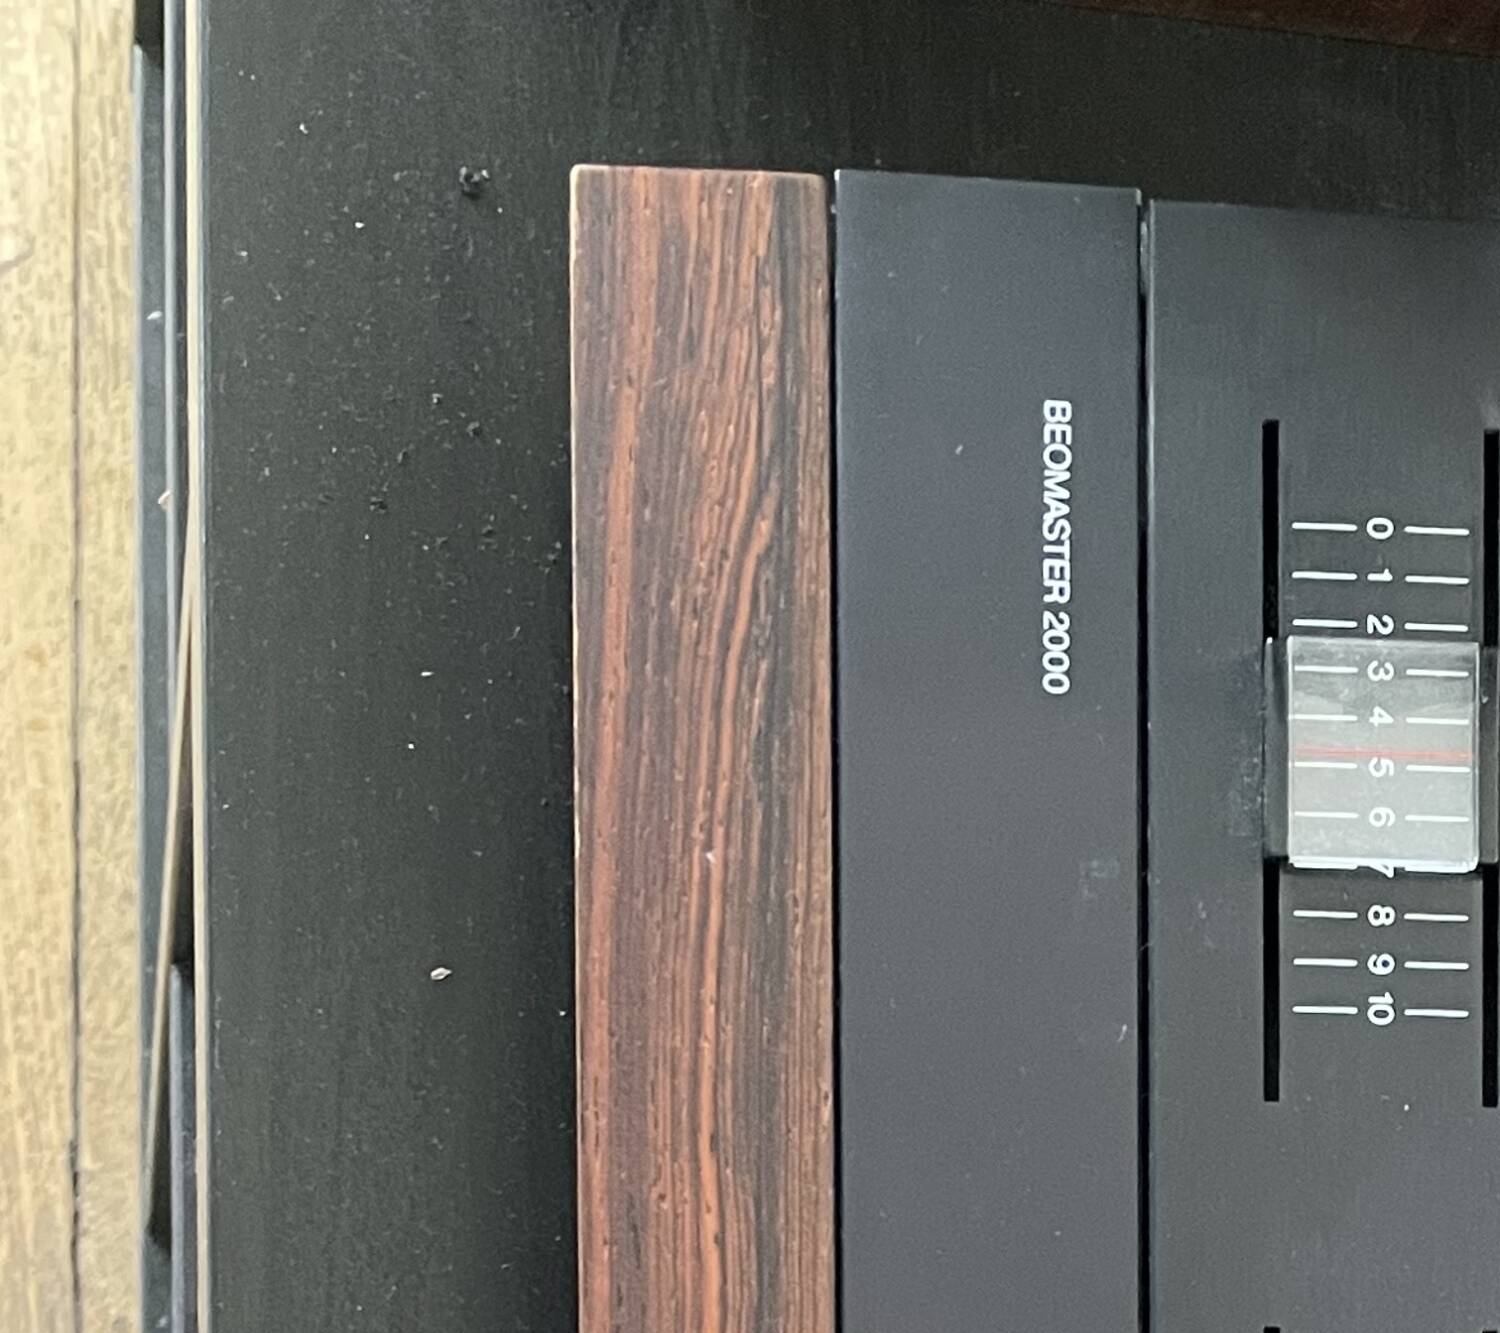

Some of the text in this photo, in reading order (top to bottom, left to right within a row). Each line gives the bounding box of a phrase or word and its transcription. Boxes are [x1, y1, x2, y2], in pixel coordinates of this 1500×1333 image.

[1366, 517, 1395, 540] 0
[1042, 399, 1073, 695] BEOMASTER 2000
[1367, 568, 1393, 582] 1
[1366, 614, 1395, 635] 2
[1367, 660, 1395, 682] 3
[1368, 706, 1395, 728] 4
[1368, 756, 1395, 778] 5
[1368, 806, 1396, 828] 6
[1367, 904, 1396, 927] 8
[1367, 953, 1396, 975] 9
[1366, 991, 1395, 1026] 10
